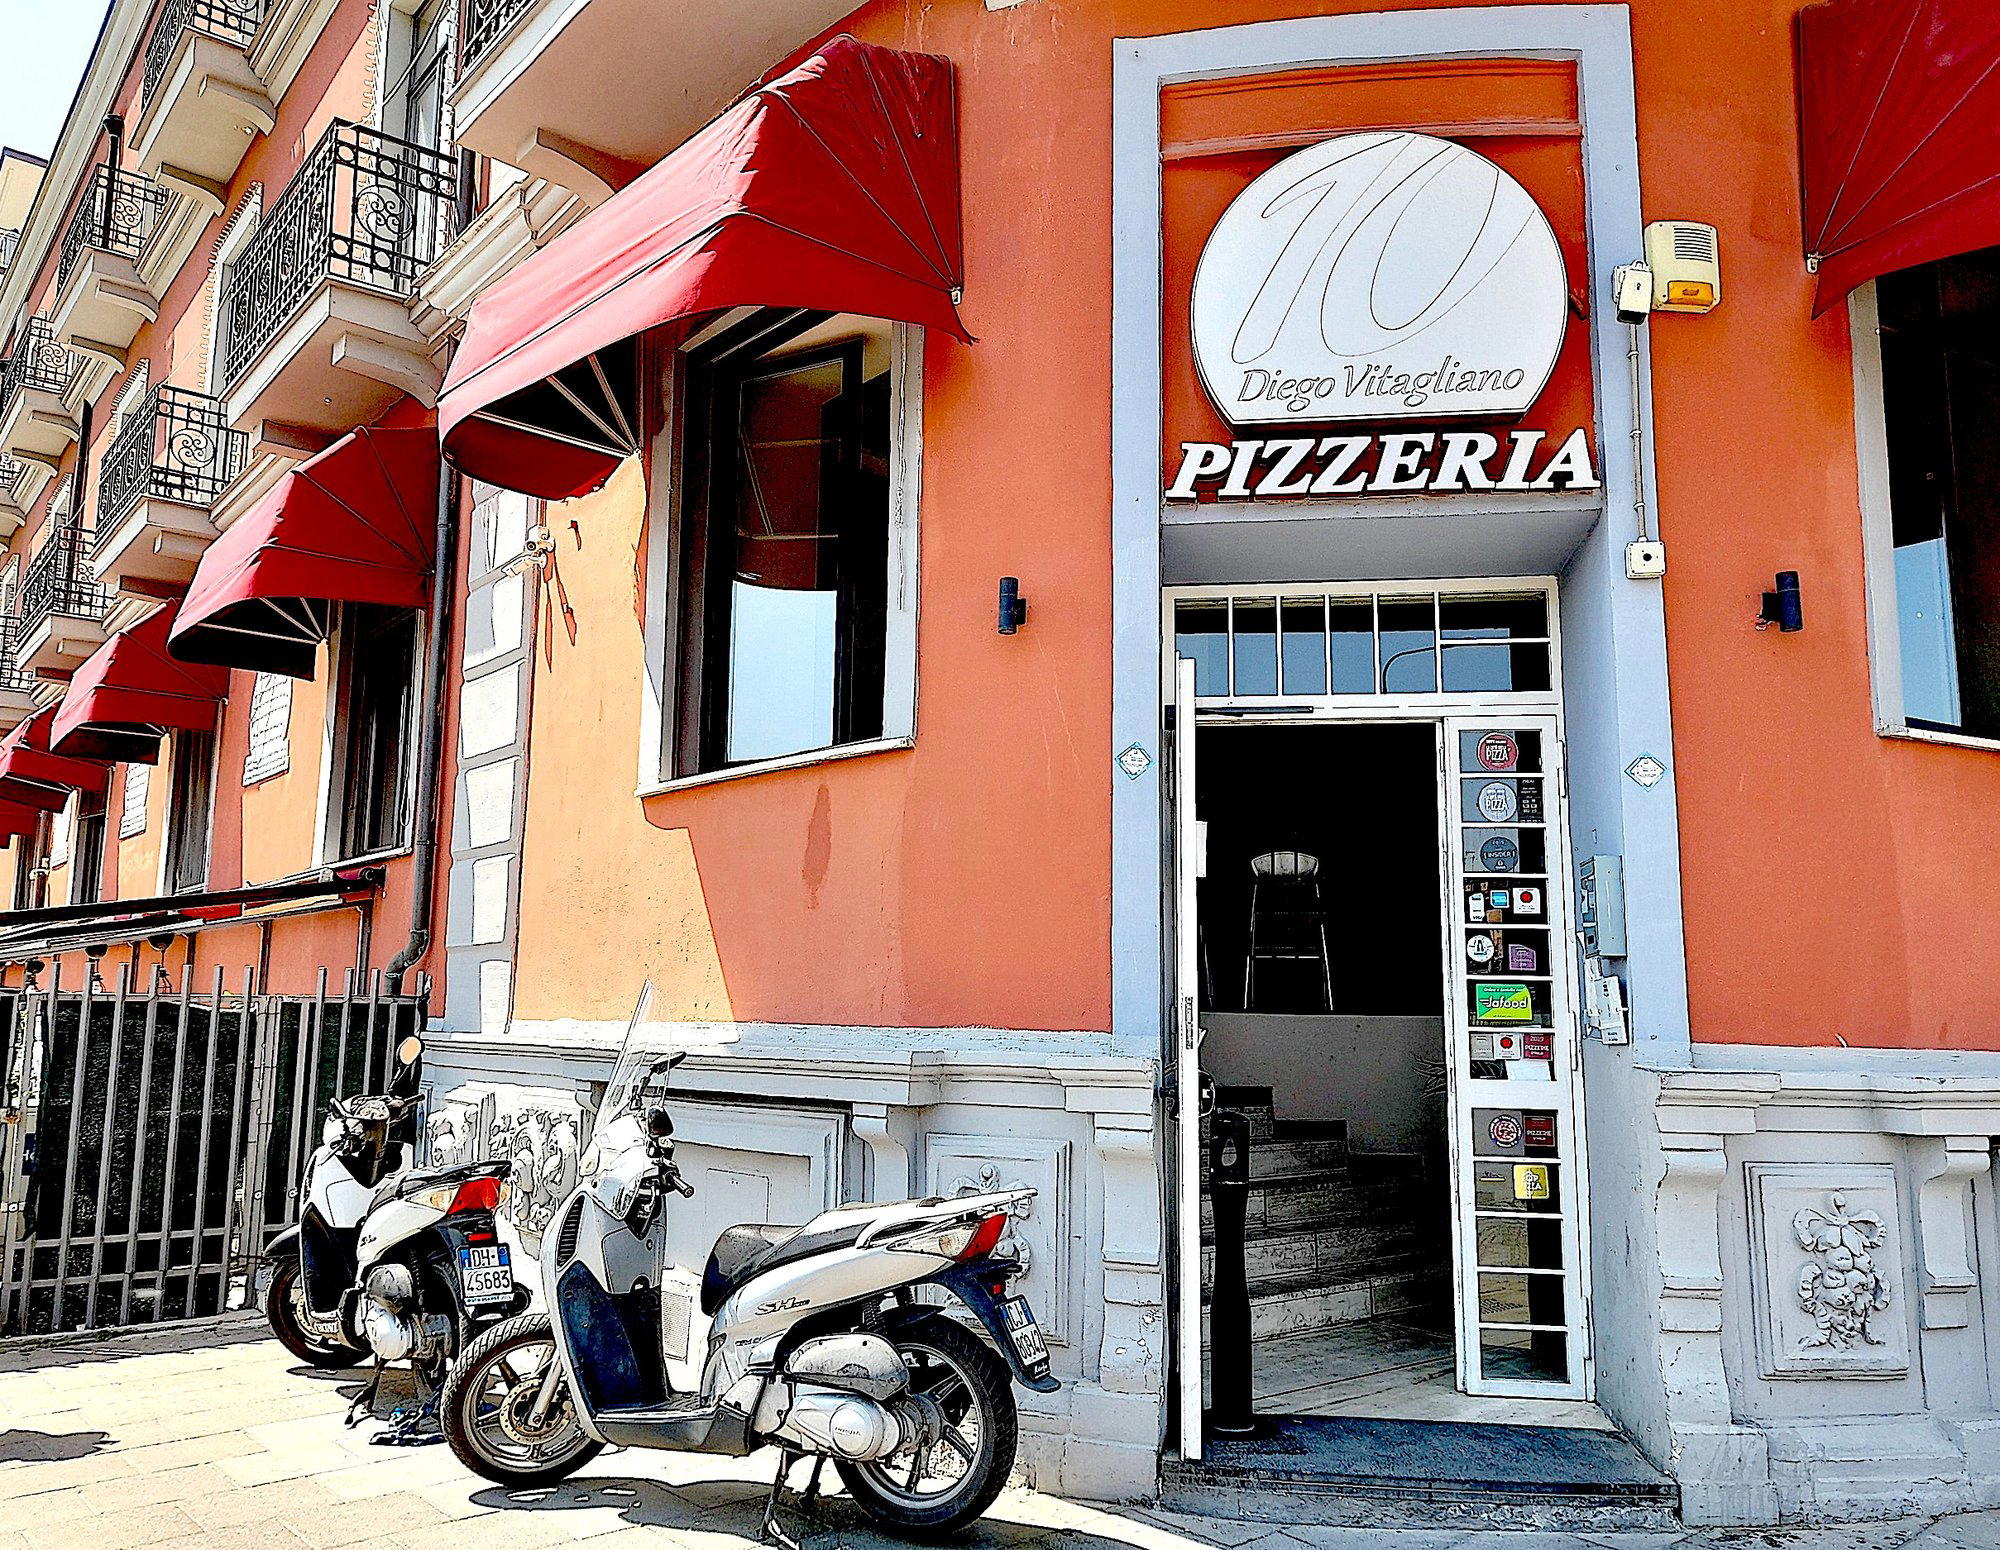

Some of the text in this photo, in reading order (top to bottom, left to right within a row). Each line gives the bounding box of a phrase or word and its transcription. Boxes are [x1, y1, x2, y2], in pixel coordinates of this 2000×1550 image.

[1236, 354, 1526, 413] Diego Vitagliano
[1165, 427, 1602, 501] PIZZERIA
[1485, 749, 1509, 761] PIZZA
[466, 1269, 510, 1292] 45683
